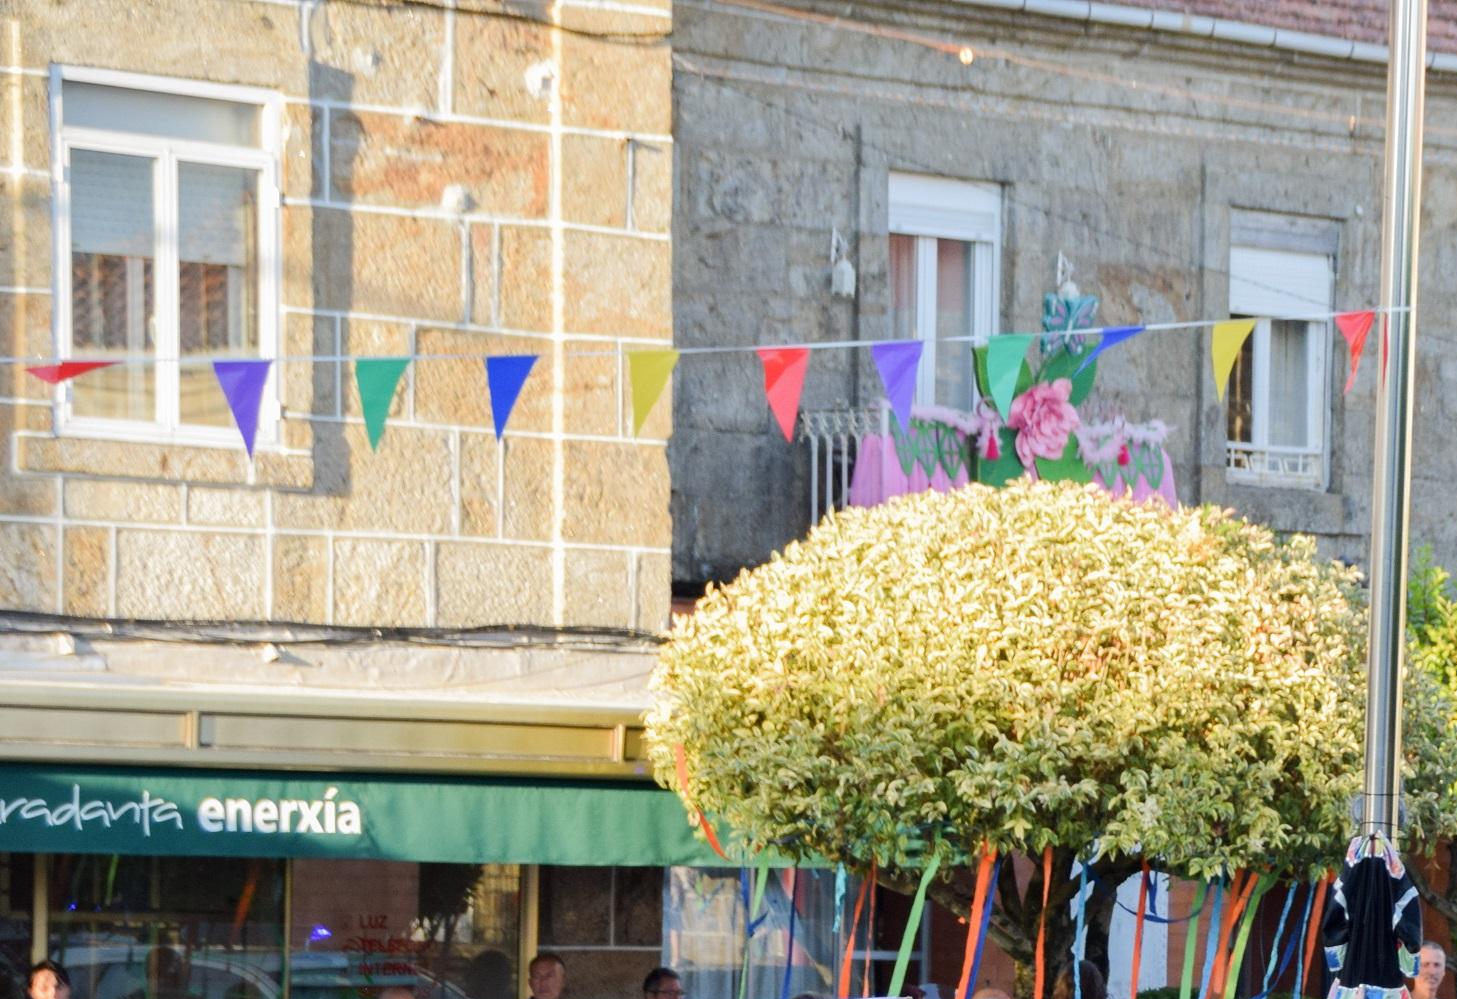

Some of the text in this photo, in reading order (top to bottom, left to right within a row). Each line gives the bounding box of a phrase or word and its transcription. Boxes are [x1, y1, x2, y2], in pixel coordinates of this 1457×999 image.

[0, 783, 361, 837] radanta enerxía
[360, 914, 388, 930] LUZ
